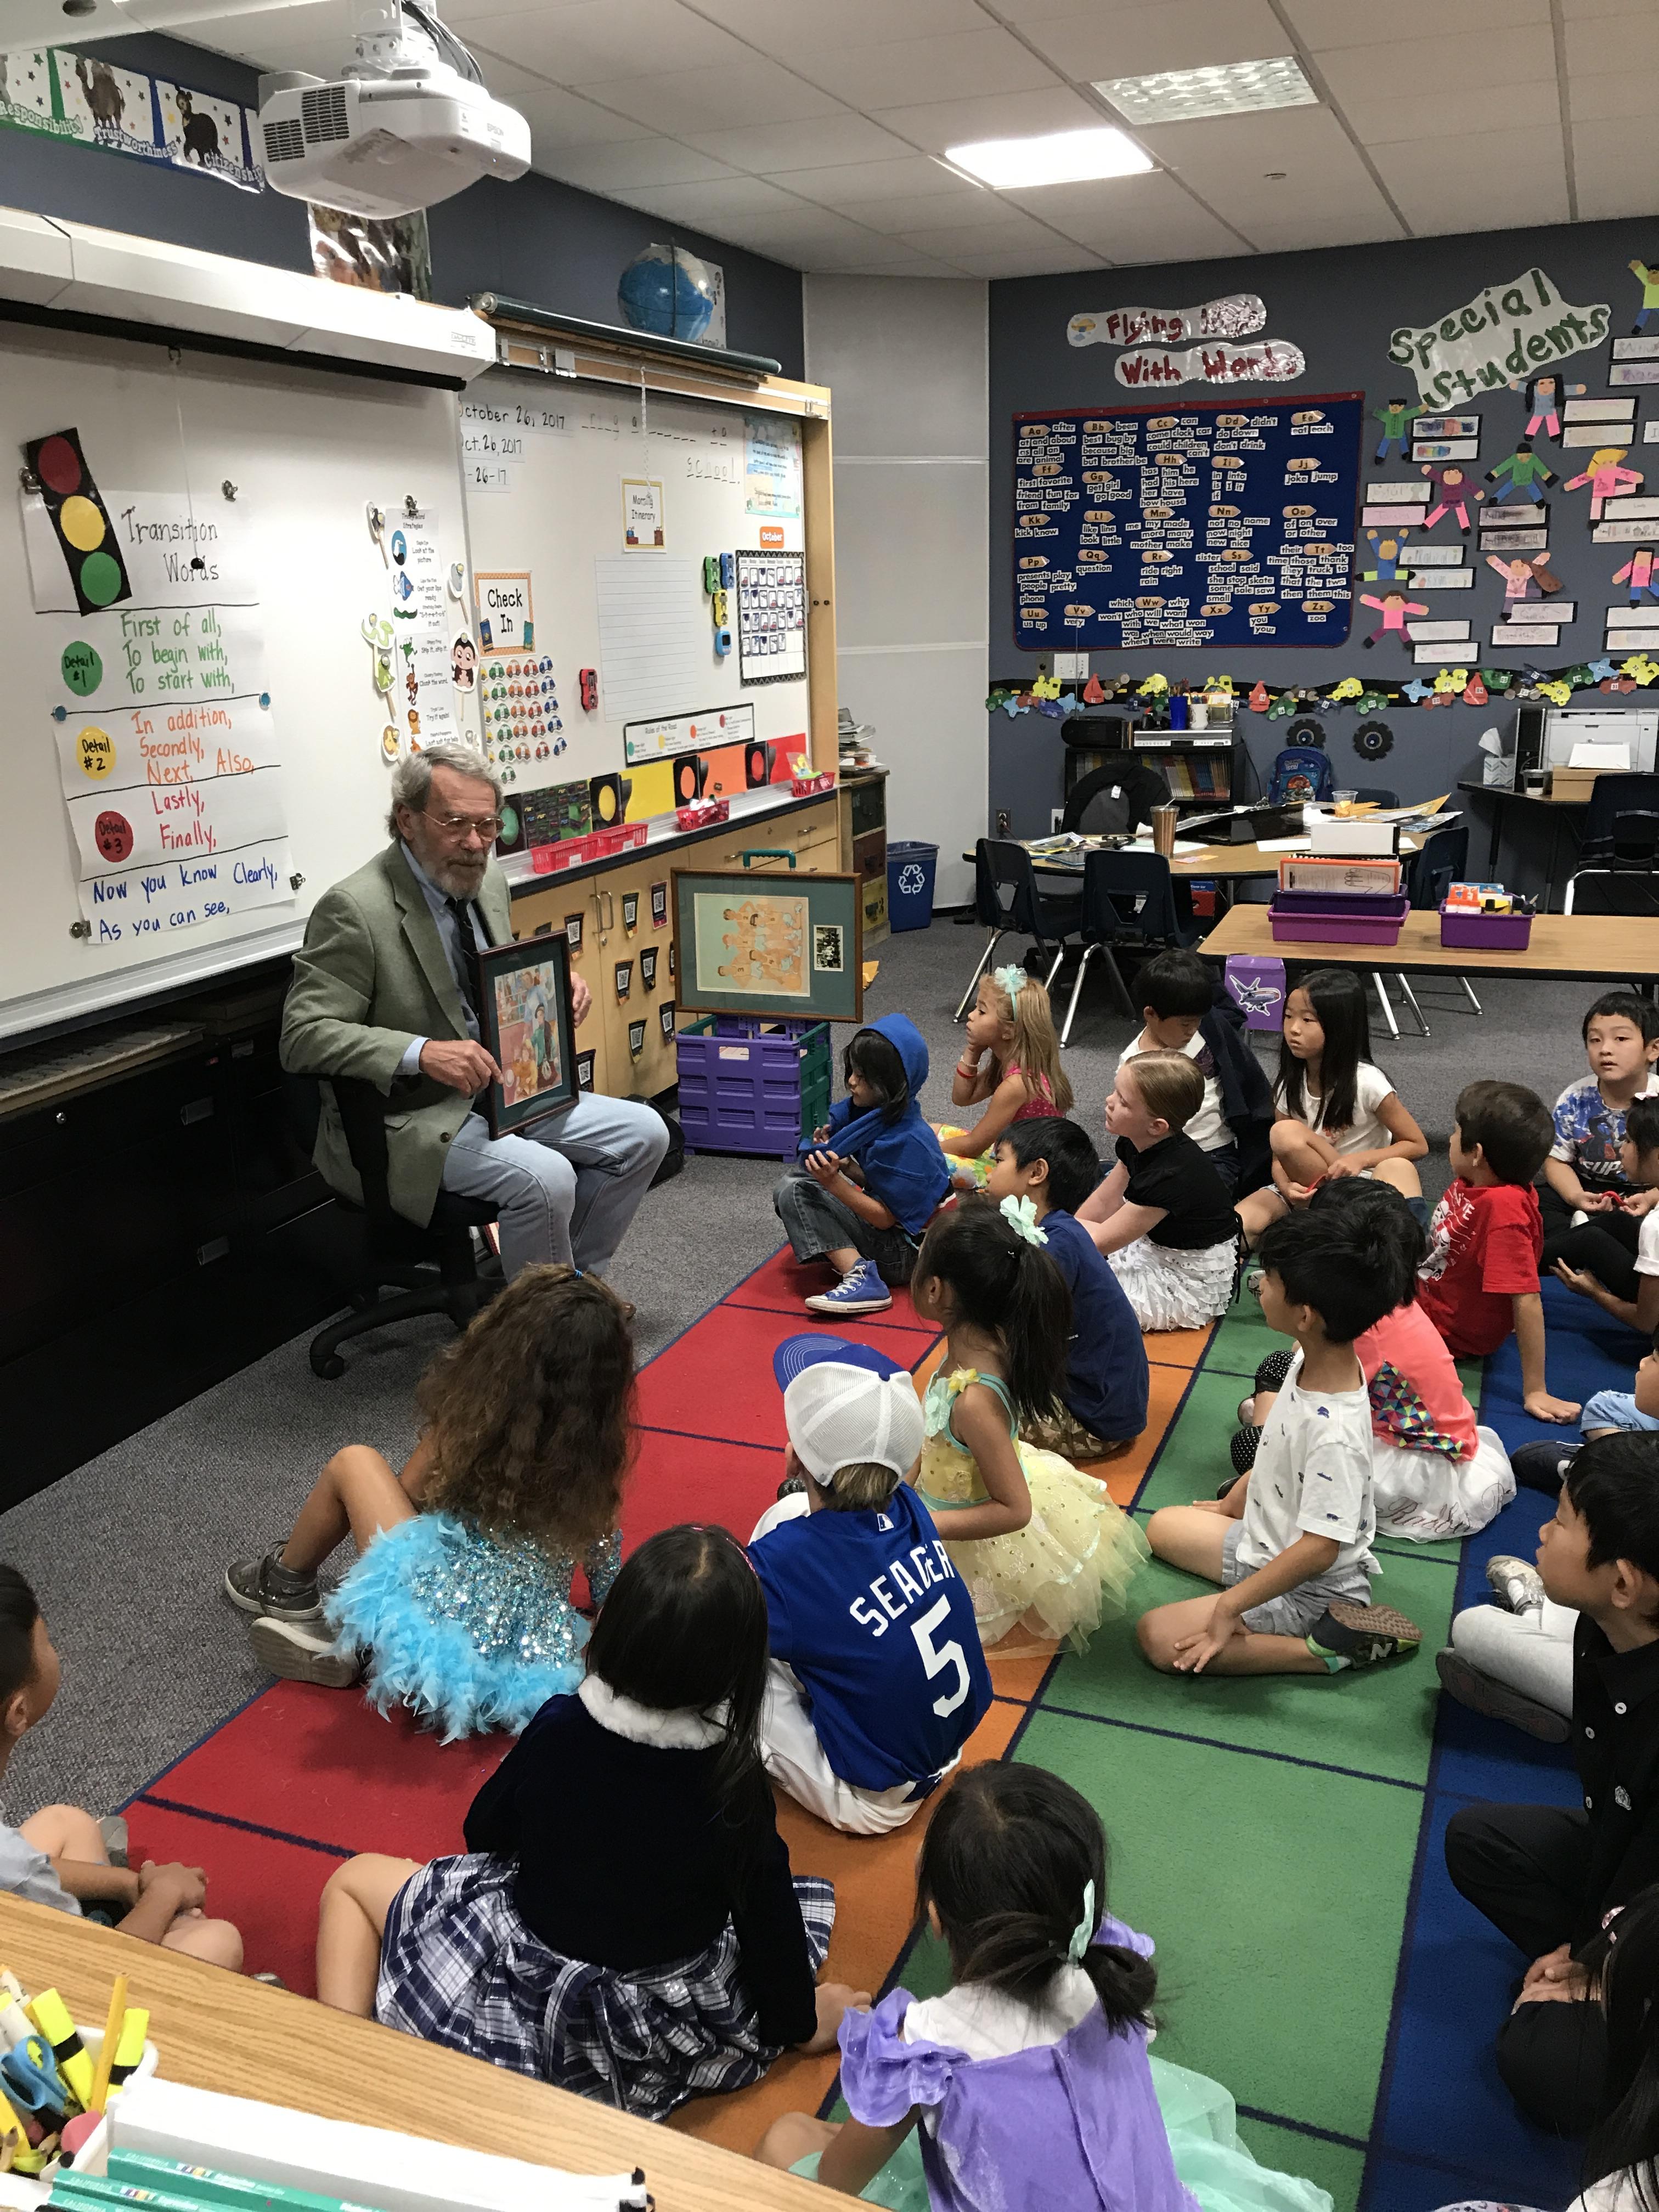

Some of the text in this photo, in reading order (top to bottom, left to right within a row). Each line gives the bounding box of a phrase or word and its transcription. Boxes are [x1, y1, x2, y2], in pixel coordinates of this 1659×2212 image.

[0, 100, 83, 134] Responsibility
[94, 126, 178, 158] Trustworthiness
[204, 153, 263, 183] Citizenship
[1107, 311, 1183, 345] Flying
[1390, 269, 1550, 369] Special
[1423, 308, 1609, 408] Students
[1121, 355, 1182, 384] With
[460, 404, 509, 422] ctober
[516, 405, 535, 426] 26,
[543, 413, 565, 429] 2017
[462, 437, 480, 451] ct.
[503, 439, 521, 454] 2017
[1107, 435, 1122, 444] bug
[1149, 441, 1170, 449] could
[1121, 447, 1133, 455] big
[1106, 481, 1119, 490] girl
[1287, 473, 1336, 483] joke jump
[632, 509, 655, 521] Itinerary
[1043, 503, 1068, 511] family
[121, 506, 218, 544] Transition
[1229, 529, 1251, 538] night
[762, 532, 782, 541] October
[1019, 571, 1070, 581] presents play
[1077, 565, 1110, 574] question
[1163, 566, 1181, 575] right
[1022, 582, 1046, 590] people
[487, 588, 523, 609] Check
[1021, 595, 1043, 603] phone
[121, 607, 222, 637] First of all,
[501, 613, 513, 634] In
[64, 652, 95, 669] Detail
[122, 637, 228, 673] To begin with,
[74, 671, 86, 687] #1
[126, 667, 235, 694] To start with,
[132, 707, 232, 735] In addition,
[82, 737, 111, 753] Detail
[140, 732, 204, 763] Secondly,
[83, 757, 106, 771] #2
[147, 748, 254, 785] Next, Also,
[151, 786, 205, 816] Lastly,
[99, 822, 125, 836] Detail
[160, 821, 217, 853] Finally,
[103, 839, 123, 854] #3
[94, 857, 278, 904] Now you know Clearly,
[99, 901, 230, 942] As you can see,
[1583, 1160, 1623, 1175] SUP
[850, 1540, 955, 1637] SEAGER
[910, 1593, 970, 1718] 5
